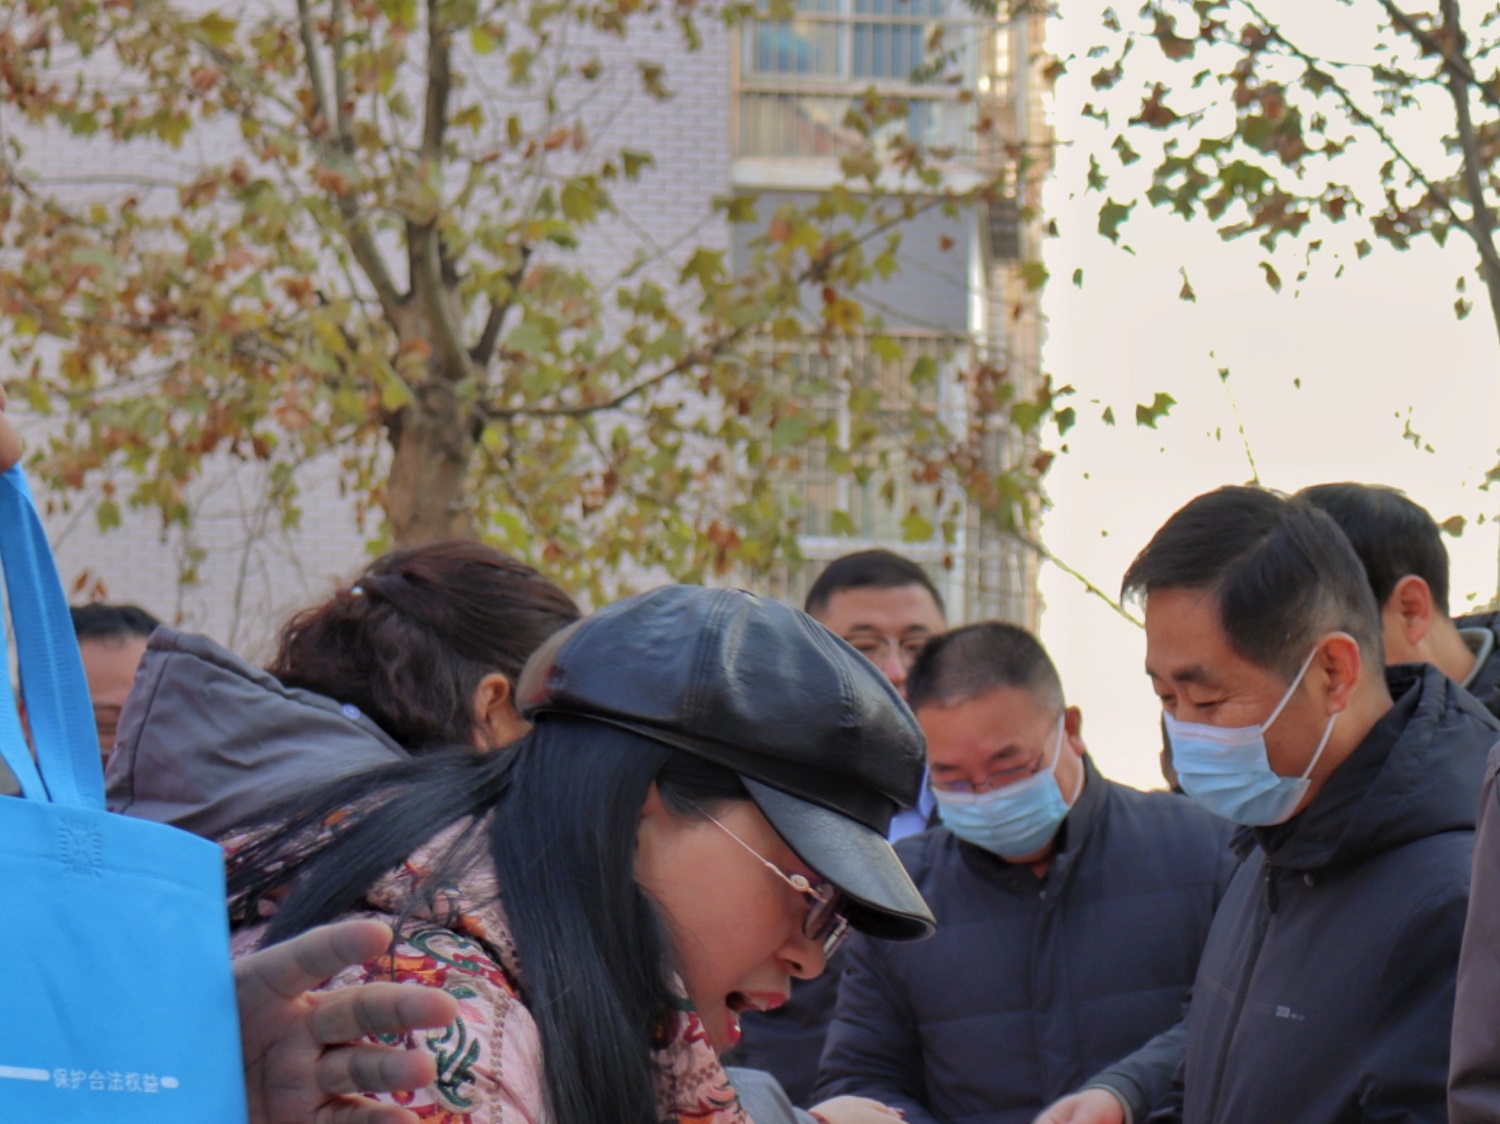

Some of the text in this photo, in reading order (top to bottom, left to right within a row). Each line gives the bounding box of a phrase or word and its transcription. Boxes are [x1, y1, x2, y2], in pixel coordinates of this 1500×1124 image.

[53, 1067, 160, 1092] 保护合法权益
